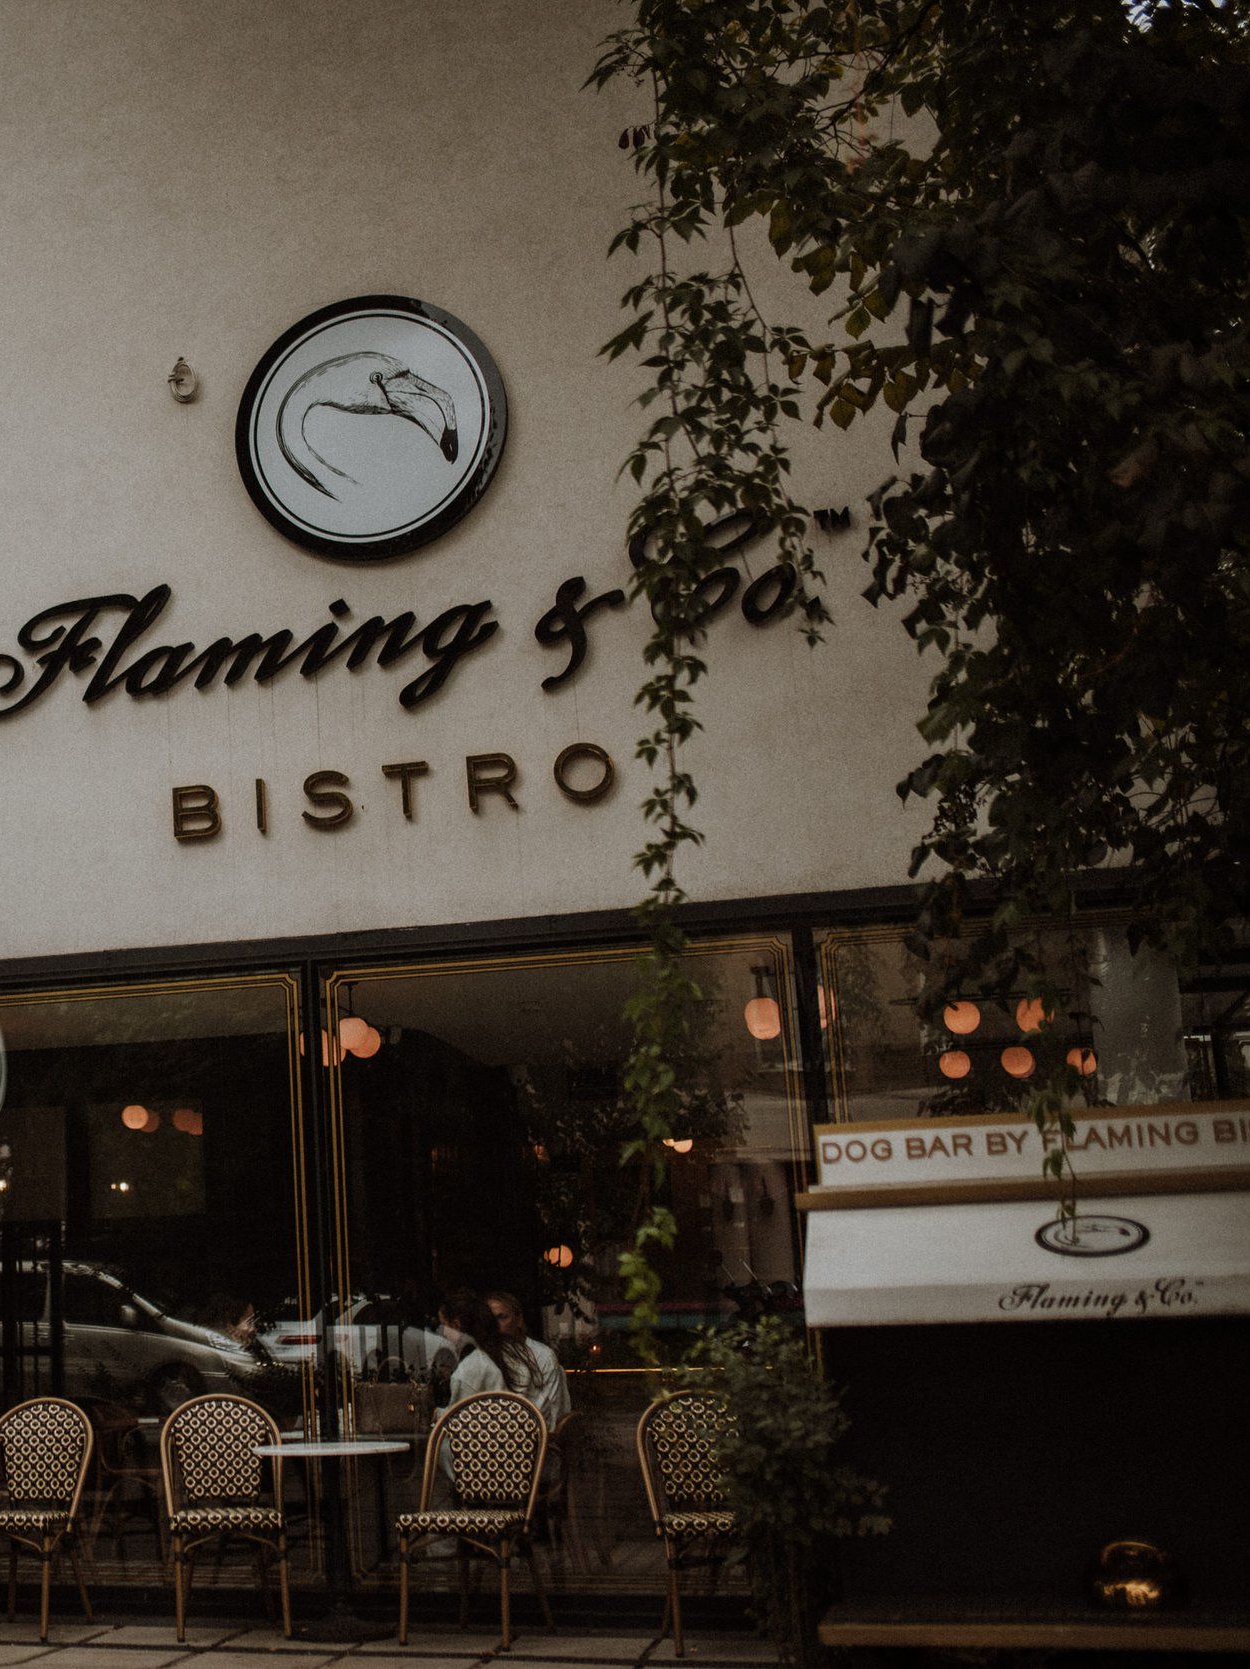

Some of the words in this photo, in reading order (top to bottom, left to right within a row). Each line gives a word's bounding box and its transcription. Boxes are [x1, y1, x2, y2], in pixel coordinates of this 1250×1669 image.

[535, 576, 625, 693] &
[172, 743, 614, 842] BISTRO
[822, 1138, 893, 1165] DOG
[905, 1134, 973, 1161] BAR
[985, 1128, 1029, 1156] BY
[1042, 1120, 1199, 1153] FLAMING
[1212, 1118, 1250, 1144] BI
[998, 1283, 1127, 1318] Flaming
[1134, 1290, 1154, 1314] &
